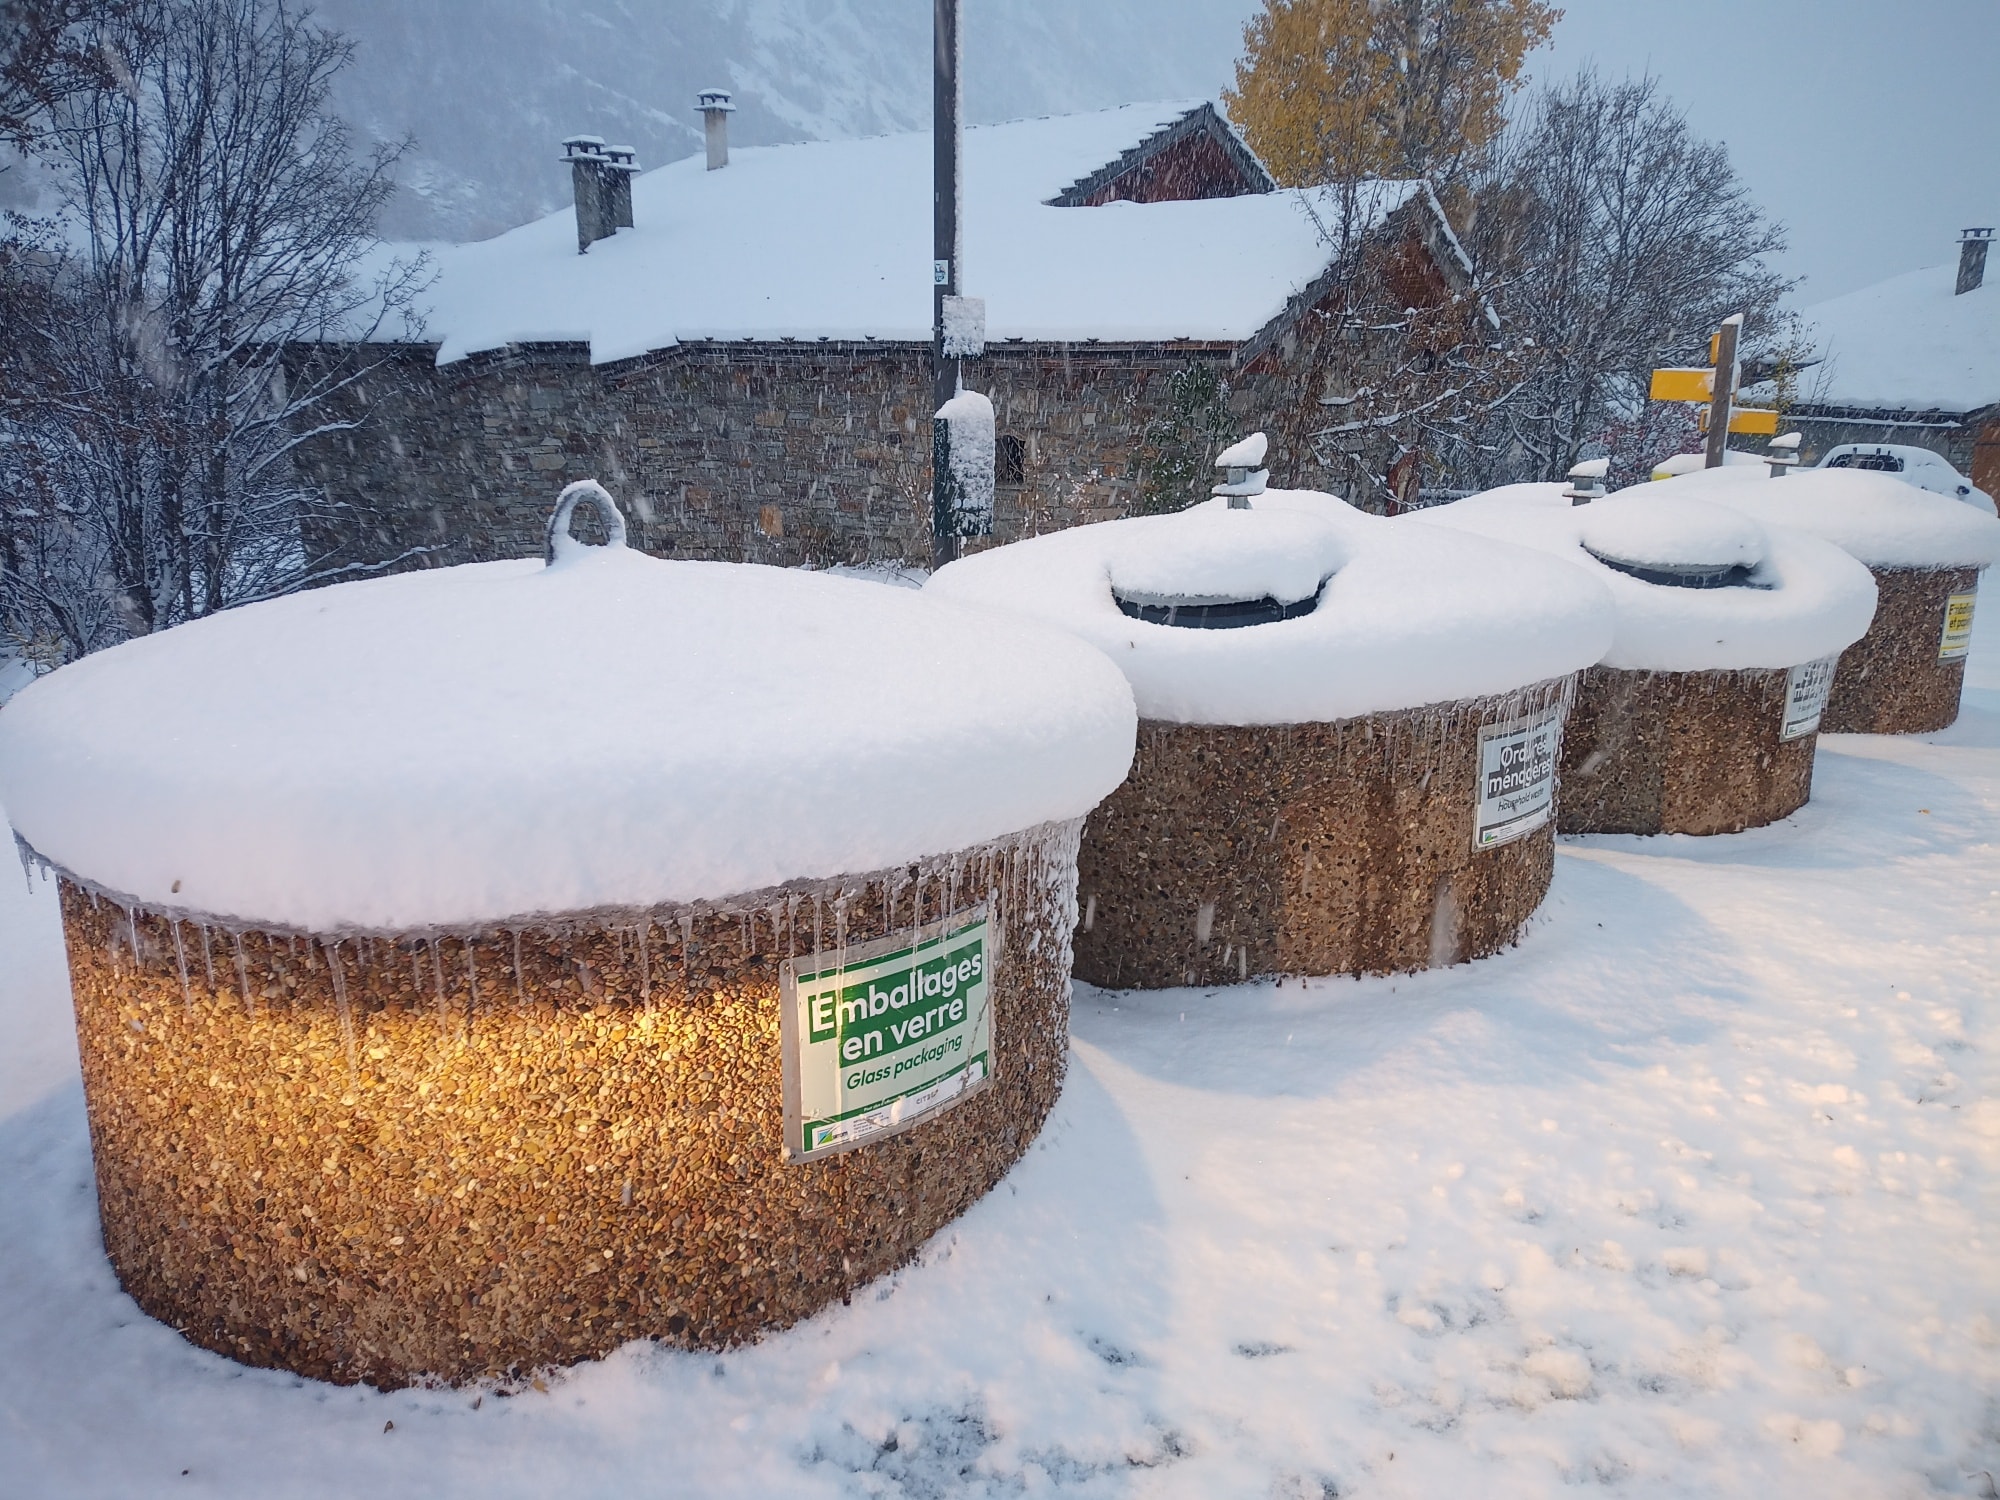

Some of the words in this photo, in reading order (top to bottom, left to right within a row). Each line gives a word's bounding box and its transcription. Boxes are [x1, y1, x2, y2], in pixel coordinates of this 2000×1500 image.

[1488, 758, 1551, 793] ménagères
[811, 953, 982, 1033] Emballages
[842, 1030, 883, 1061] en
[890, 998, 964, 1045] verre
[847, 1065, 891, 1090] Glass
[894, 1034, 963, 1079] packaging
